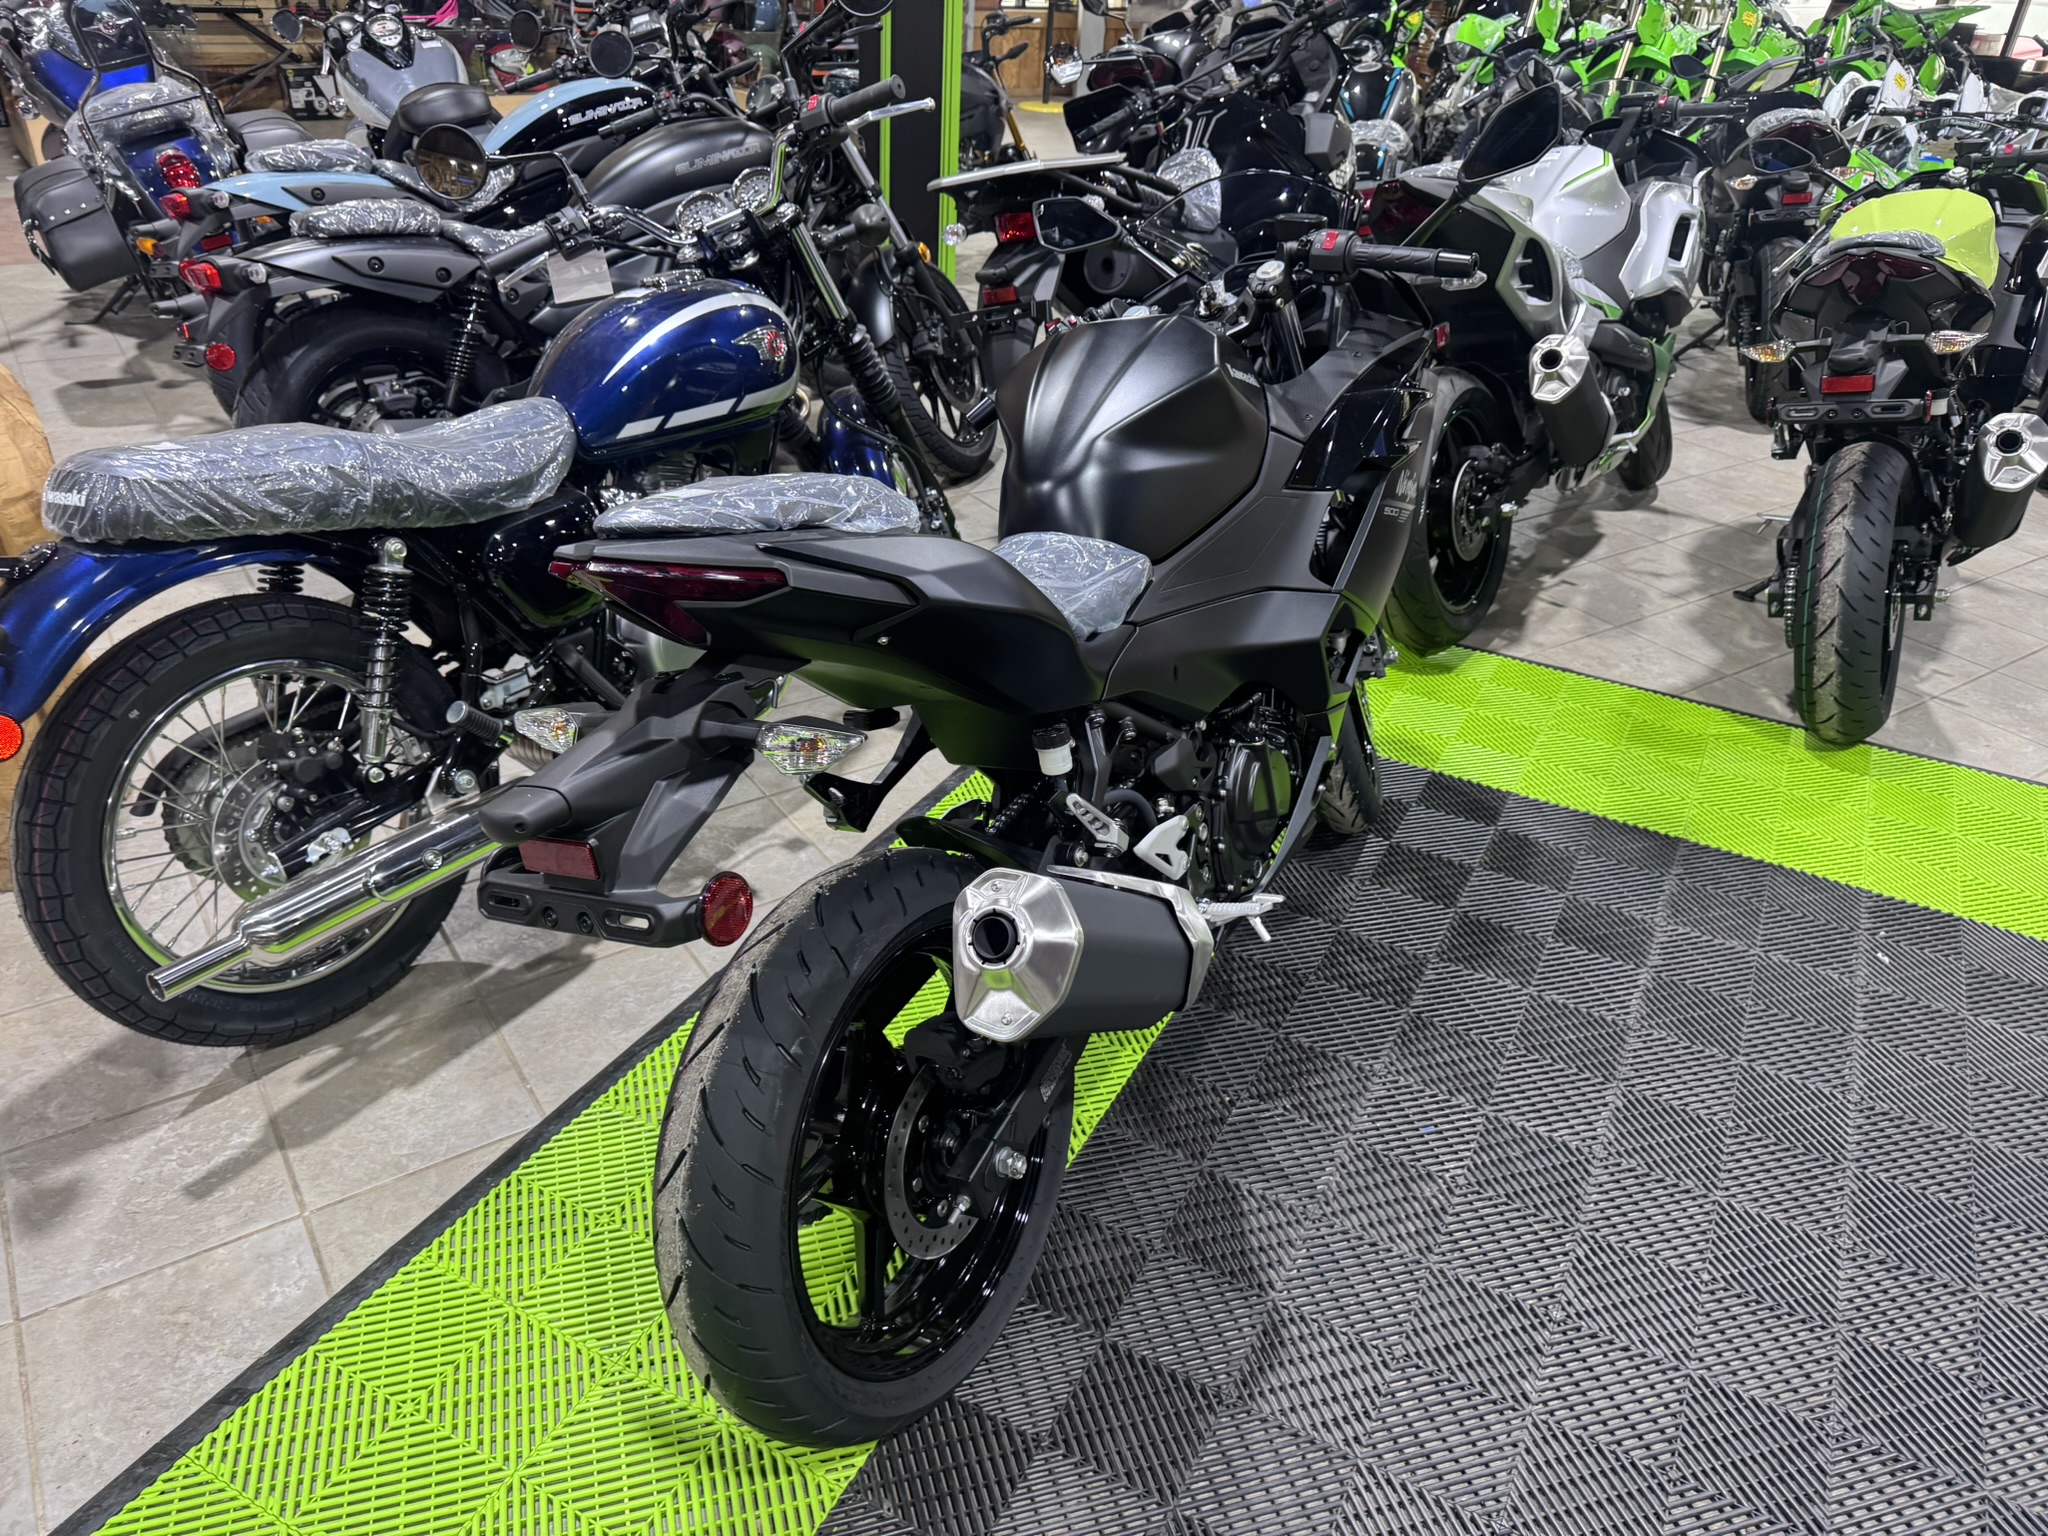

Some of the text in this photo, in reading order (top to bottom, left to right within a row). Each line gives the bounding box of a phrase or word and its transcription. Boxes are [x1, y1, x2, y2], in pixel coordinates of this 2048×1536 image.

[568, 97, 644, 126] ELIMINATOR
[675, 142, 761, 176] ELIMINATOR
[1396, 469, 1418, 502] Ninja
[1383, 506, 1400, 517] 500
